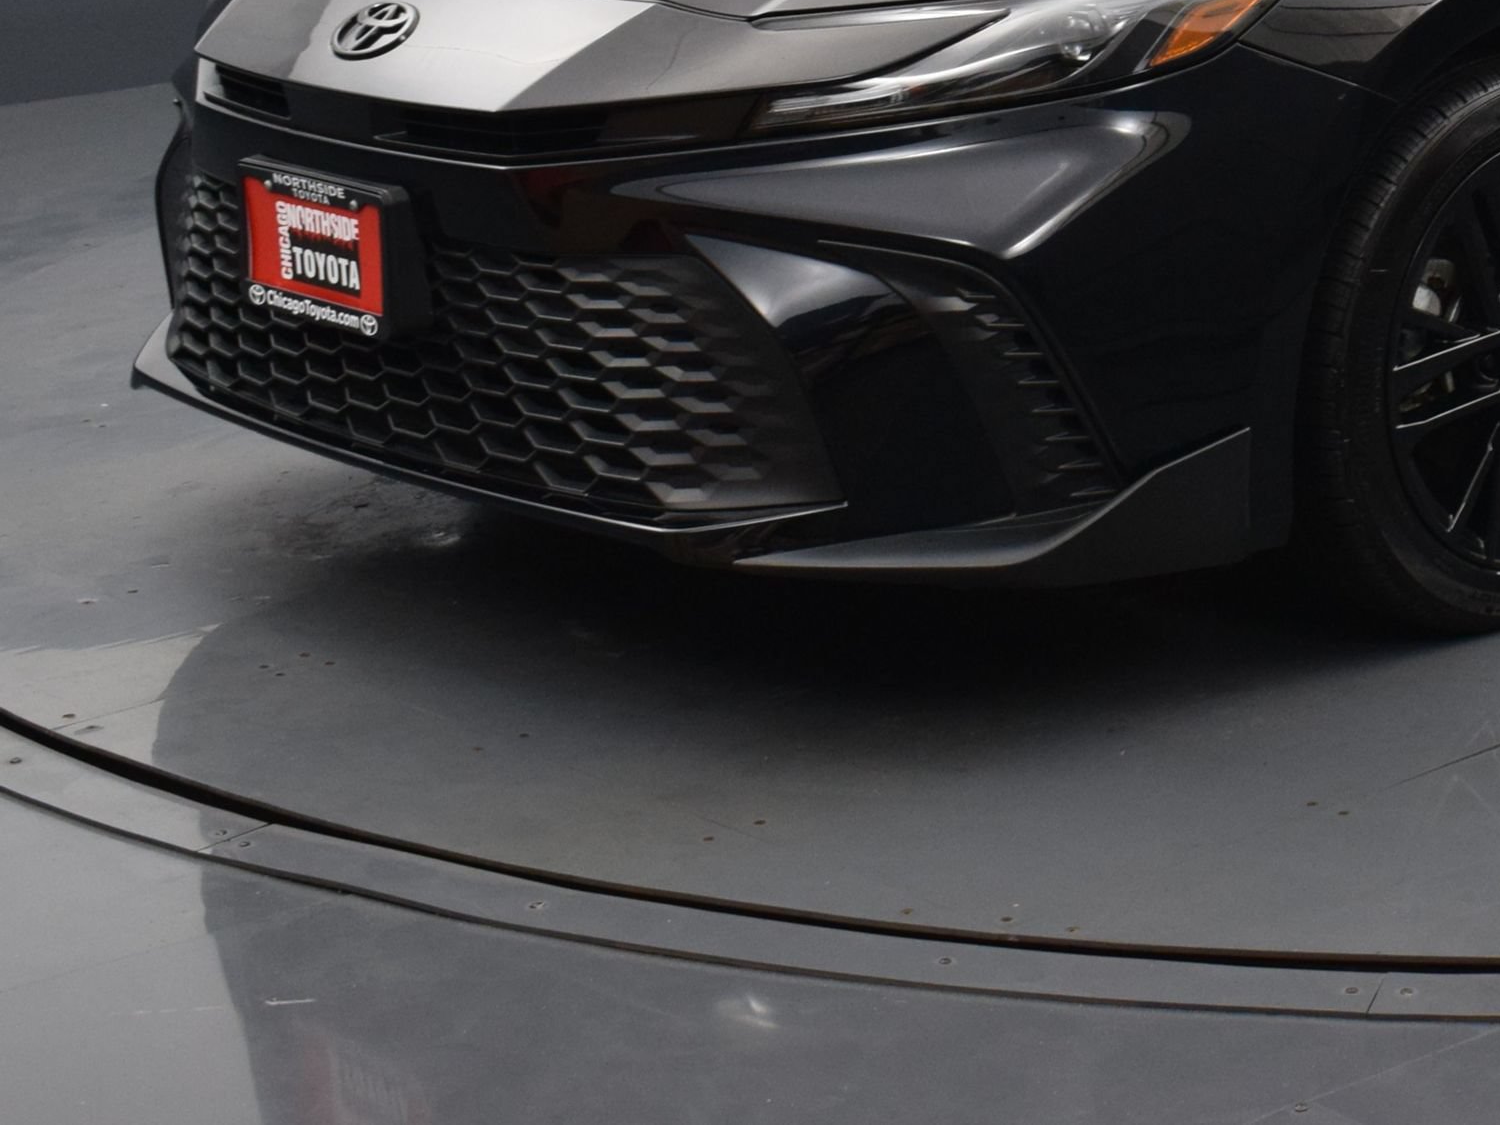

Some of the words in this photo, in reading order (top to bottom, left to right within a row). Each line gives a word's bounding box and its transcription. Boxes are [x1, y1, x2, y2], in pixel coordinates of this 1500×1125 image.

[273, 173, 345, 199] NORTHSIDE
[292, 188, 330, 204] TOYOTA
[276, 201, 294, 279] CHICAGO
[287, 204, 360, 240] NORTHSIDE
[293, 246, 360, 290] TOYOTA
[267, 290, 360, 328] ChicagoToyota.com
